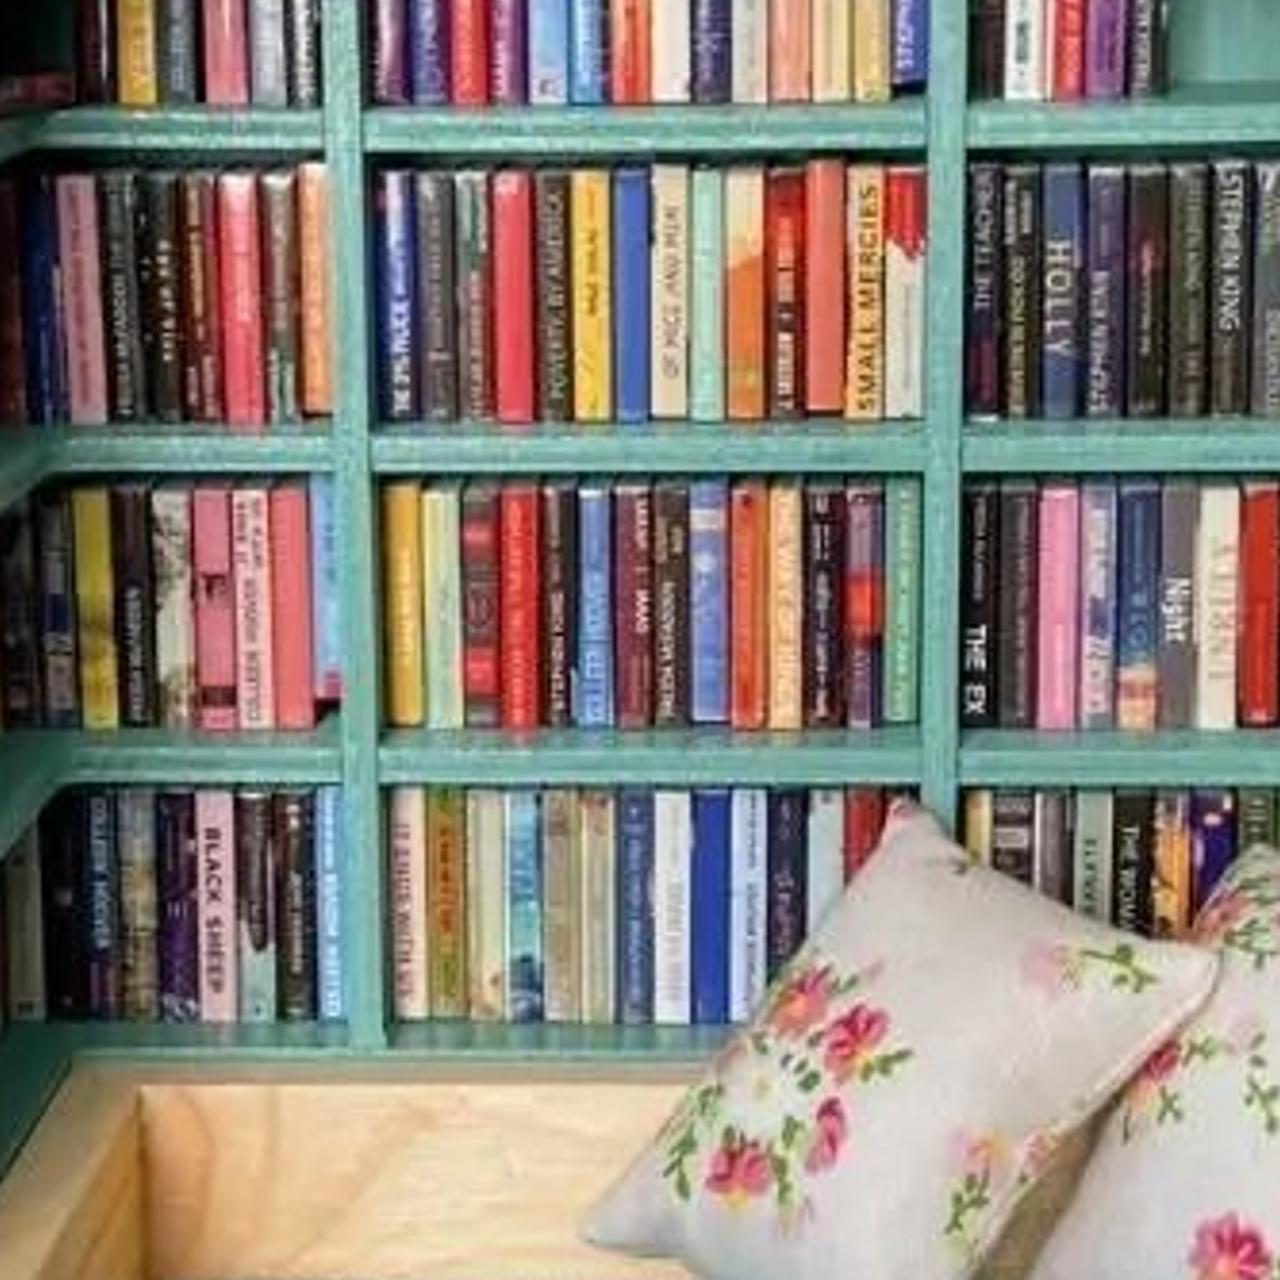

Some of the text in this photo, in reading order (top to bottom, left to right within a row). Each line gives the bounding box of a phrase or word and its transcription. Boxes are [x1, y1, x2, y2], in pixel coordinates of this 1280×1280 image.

[663, 205, 680, 379] OF MICE AND MEN
[974, 171, 994, 310] THE TEACHER
[1219, 172, 1240, 331] STEPHEN KING
[546, 189, 568, 399] POVERTY, BY AMERICA
[857, 185, 878, 411] SMALL MERCIES
[1045, 239, 1073, 356] HOLLY
[777, 492, 795, 540] THE
[776, 545, 795, 602] WAY
[777, 605, 794, 640] OF
[1162, 577, 1191, 642] Night
[245, 650, 262, 722] COLLEEN
[964, 624, 987, 715] THE EX
[1121, 824, 1141, 863] THE
[203, 827, 223, 995] BLACK SHEEP
